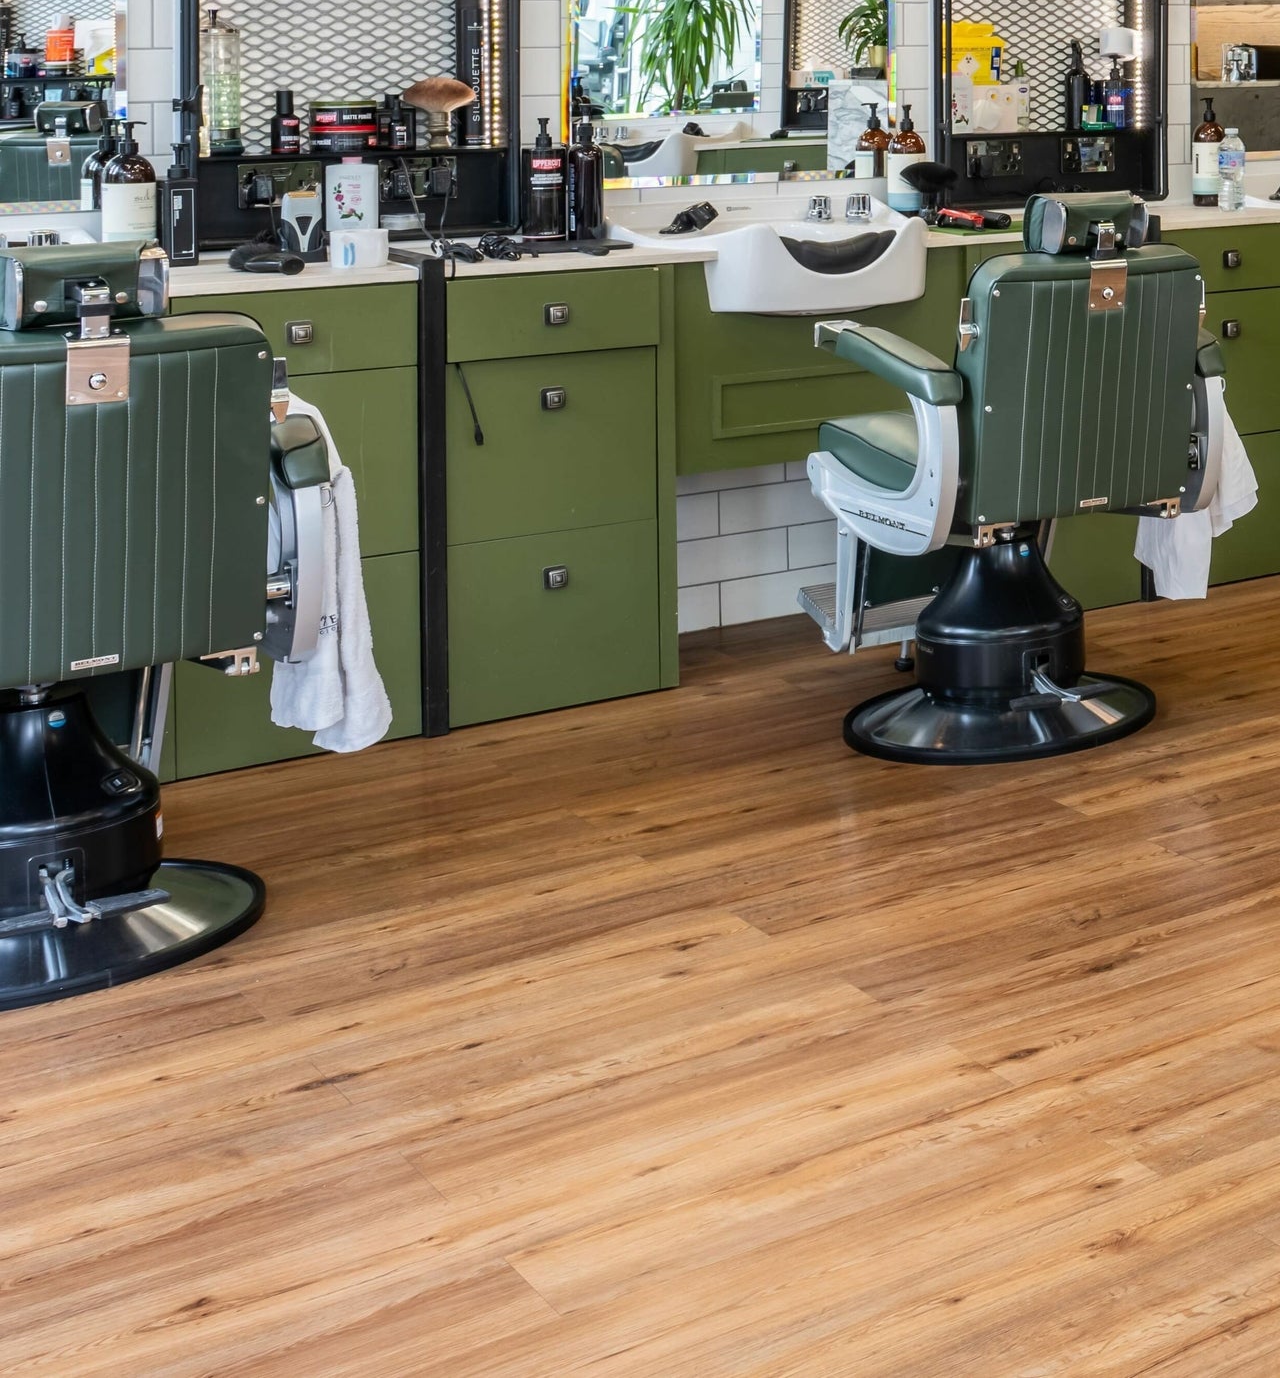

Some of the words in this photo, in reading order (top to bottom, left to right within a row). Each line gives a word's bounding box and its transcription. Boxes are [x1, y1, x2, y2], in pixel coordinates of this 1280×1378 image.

[472, 48, 481, 122] SILHOUETTE
[532, 158, 561, 168] UPPERCUT
[858, 509, 906, 531] BELMONT
